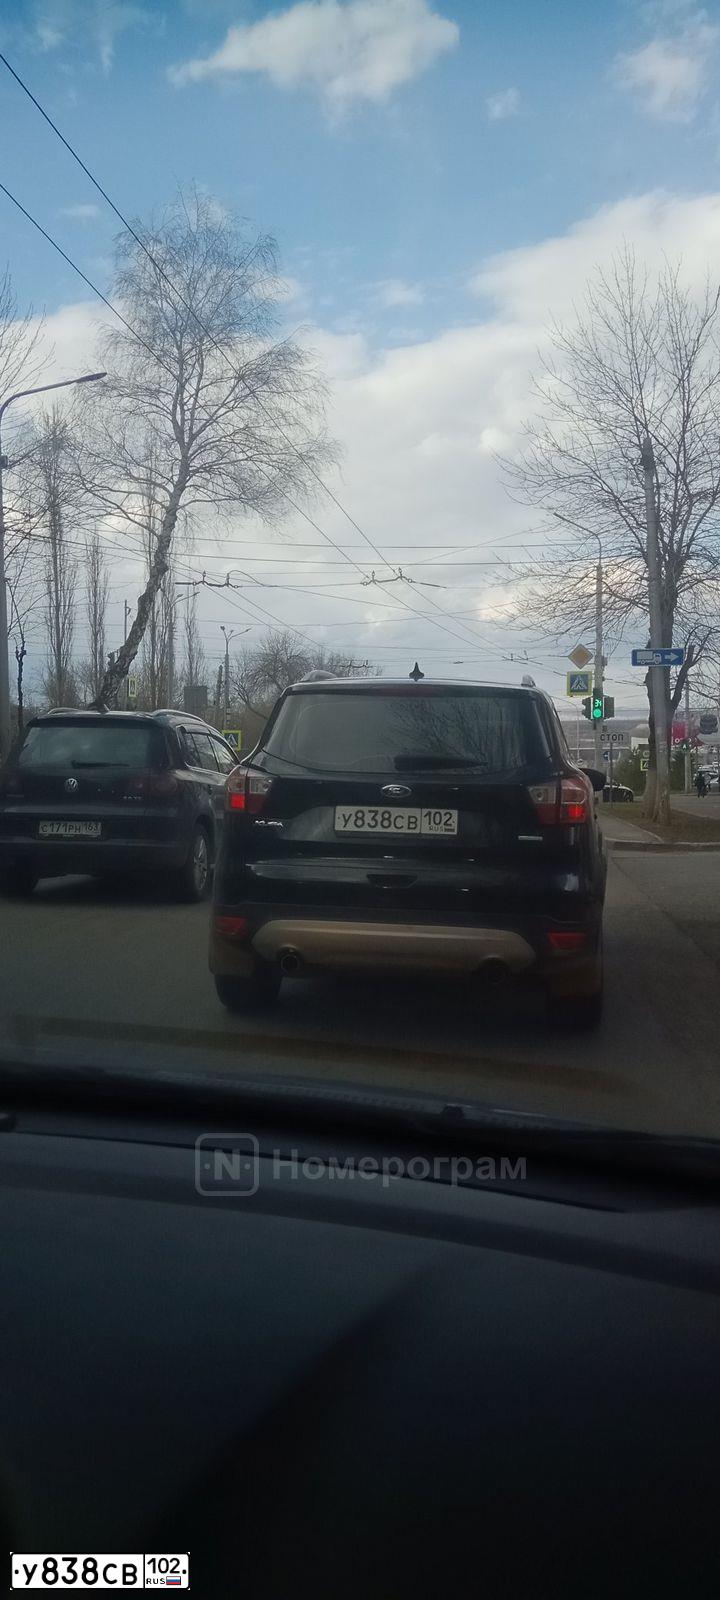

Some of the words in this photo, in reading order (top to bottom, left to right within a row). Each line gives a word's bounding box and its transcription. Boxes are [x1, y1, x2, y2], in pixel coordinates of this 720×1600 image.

[600, 733, 624, 741] СТОП
[342, 809, 418, 830] У838СВ
[424, 811, 453, 826] 102
[41, 822, 81, 833] С171РН
[85, 822, 98, 831] 163
